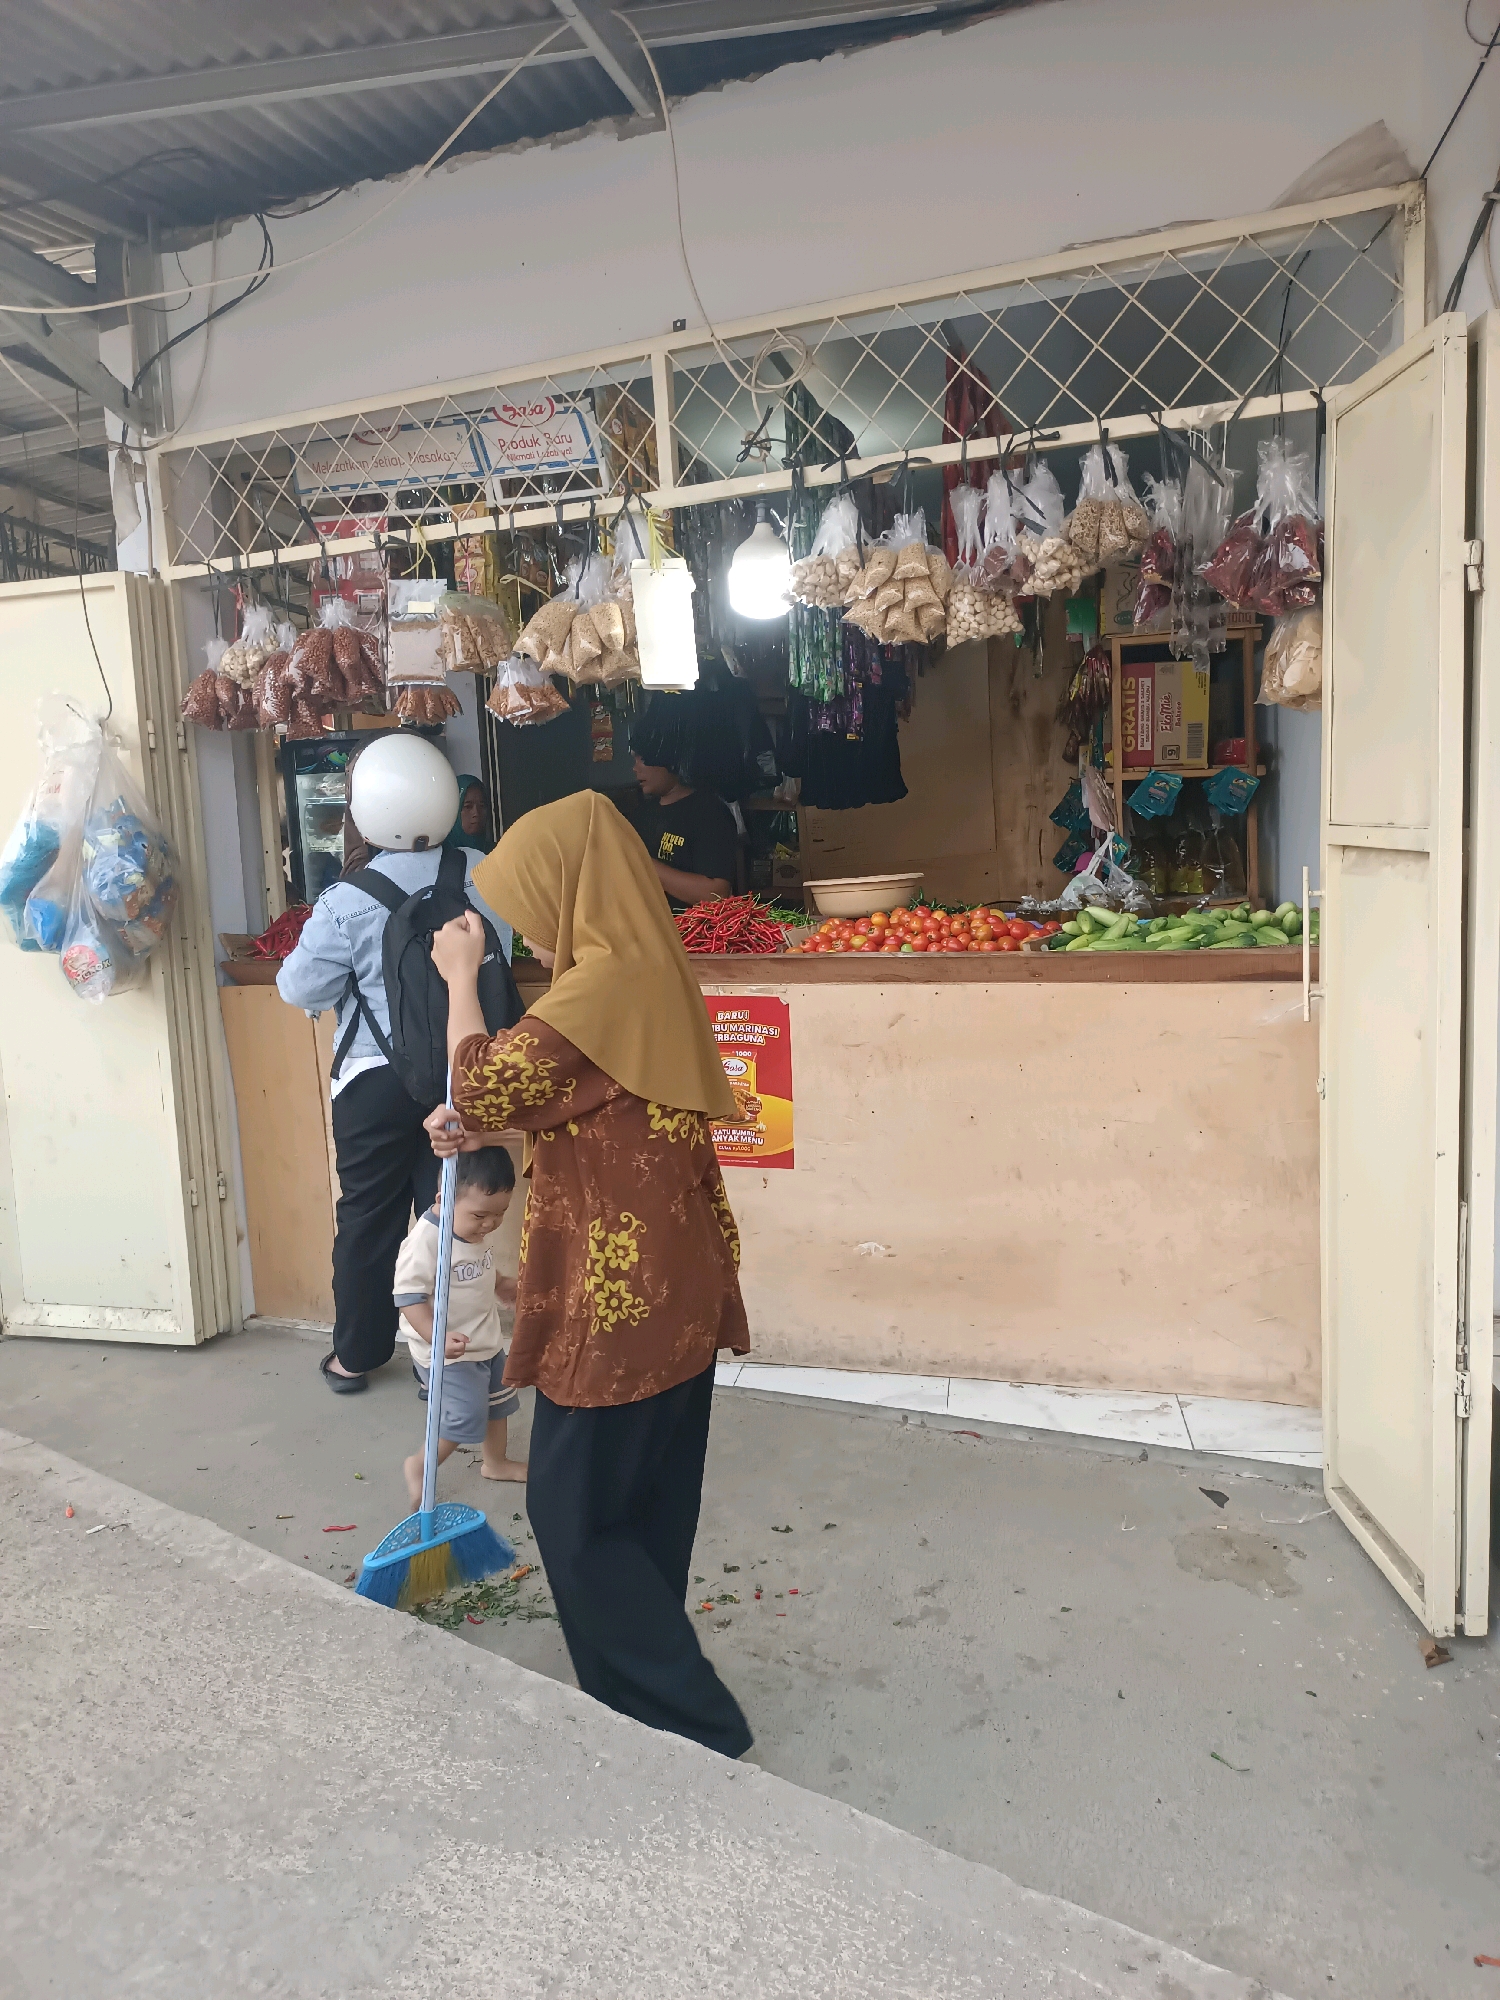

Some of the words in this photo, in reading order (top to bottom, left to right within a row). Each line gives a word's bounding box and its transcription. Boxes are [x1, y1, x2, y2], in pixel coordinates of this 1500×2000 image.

[498, 434, 541, 451] Produk
[543, 432, 573, 445] Baru
[312, 457, 370, 474] Melezatkan
[373, 454, 405, 469] Setiap
[408, 449, 458, 465] Masakan
[506, 451, 536, 461] Nikmati
[1122, 676, 1136, 753] GRATIS
[661, 831, 685, 847] NEVER
[717, 1011, 749, 1021] BARU!
[729, 1024, 779, 1036] MARINASI
[714, 1033, 764, 1044] ERBAGUNA
[731, 1129, 756, 1138] BUMBU
[711, 1134, 739, 1143] ANYAK
[740, 1136, 764, 1146] MENU
